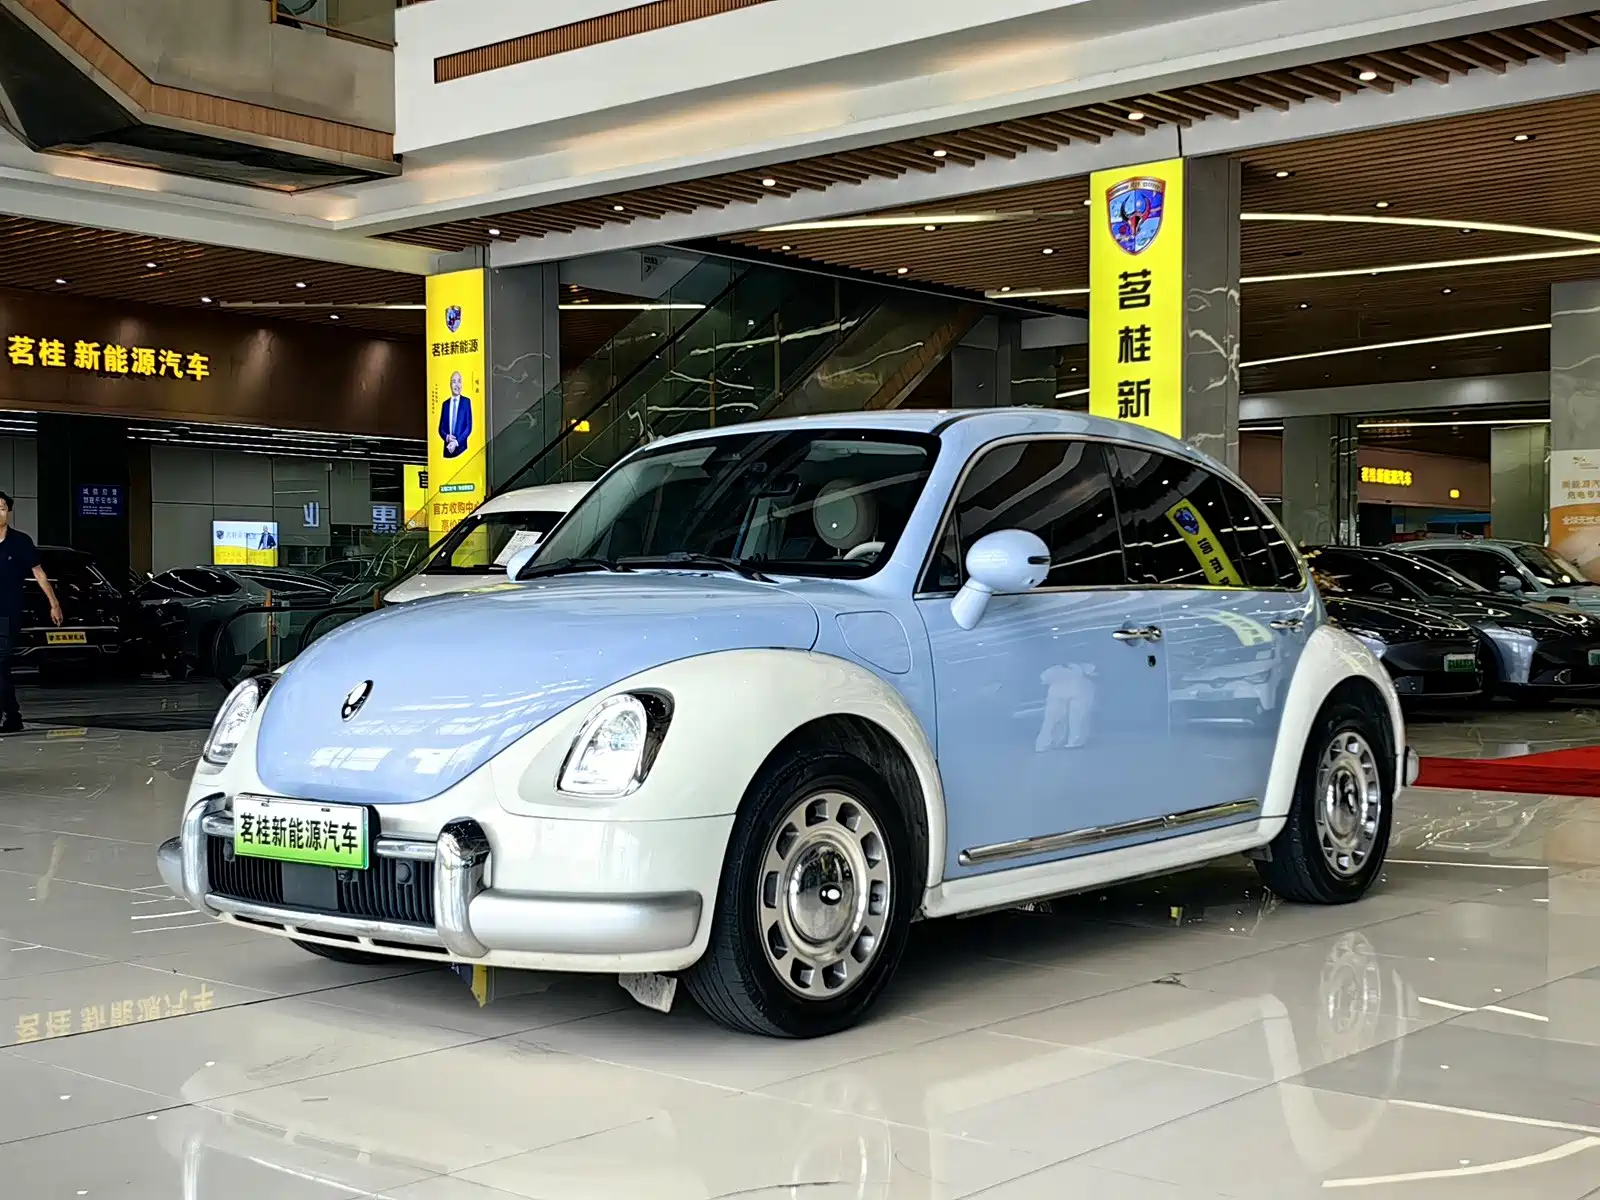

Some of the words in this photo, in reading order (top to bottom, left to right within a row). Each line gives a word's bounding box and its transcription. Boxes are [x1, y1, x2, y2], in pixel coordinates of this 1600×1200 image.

[431, 339, 479, 357] 茗桂新能源
[1117, 268, 1152, 419] 茗桂新
[240, 812, 358, 854] 茗桂新能源汽车
